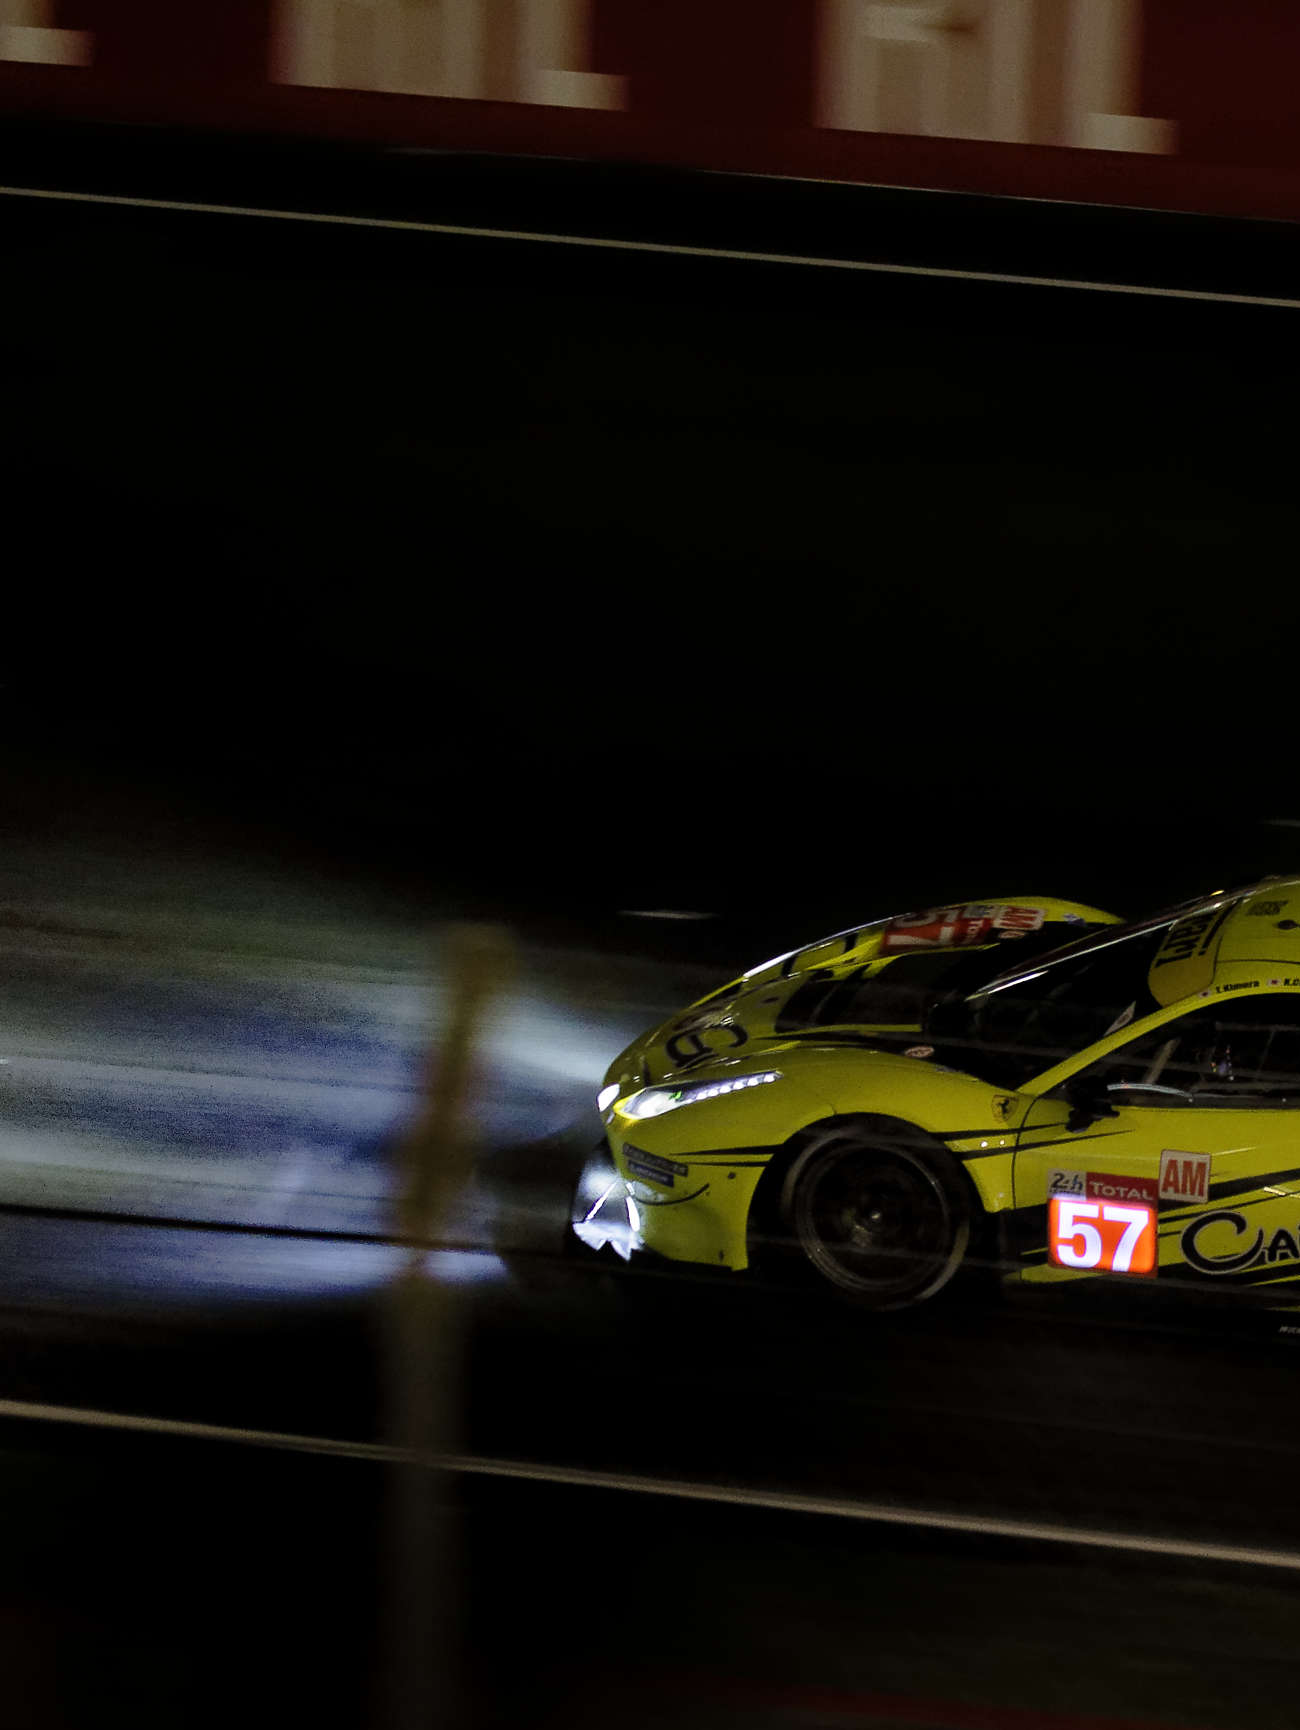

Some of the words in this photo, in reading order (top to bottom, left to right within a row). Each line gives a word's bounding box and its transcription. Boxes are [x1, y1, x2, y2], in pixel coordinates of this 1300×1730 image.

[1088, 1180, 1154, 1201] TOTAL
[1160, 1158, 1207, 1198] AM
[1055, 1200, 1150, 1273] 57
